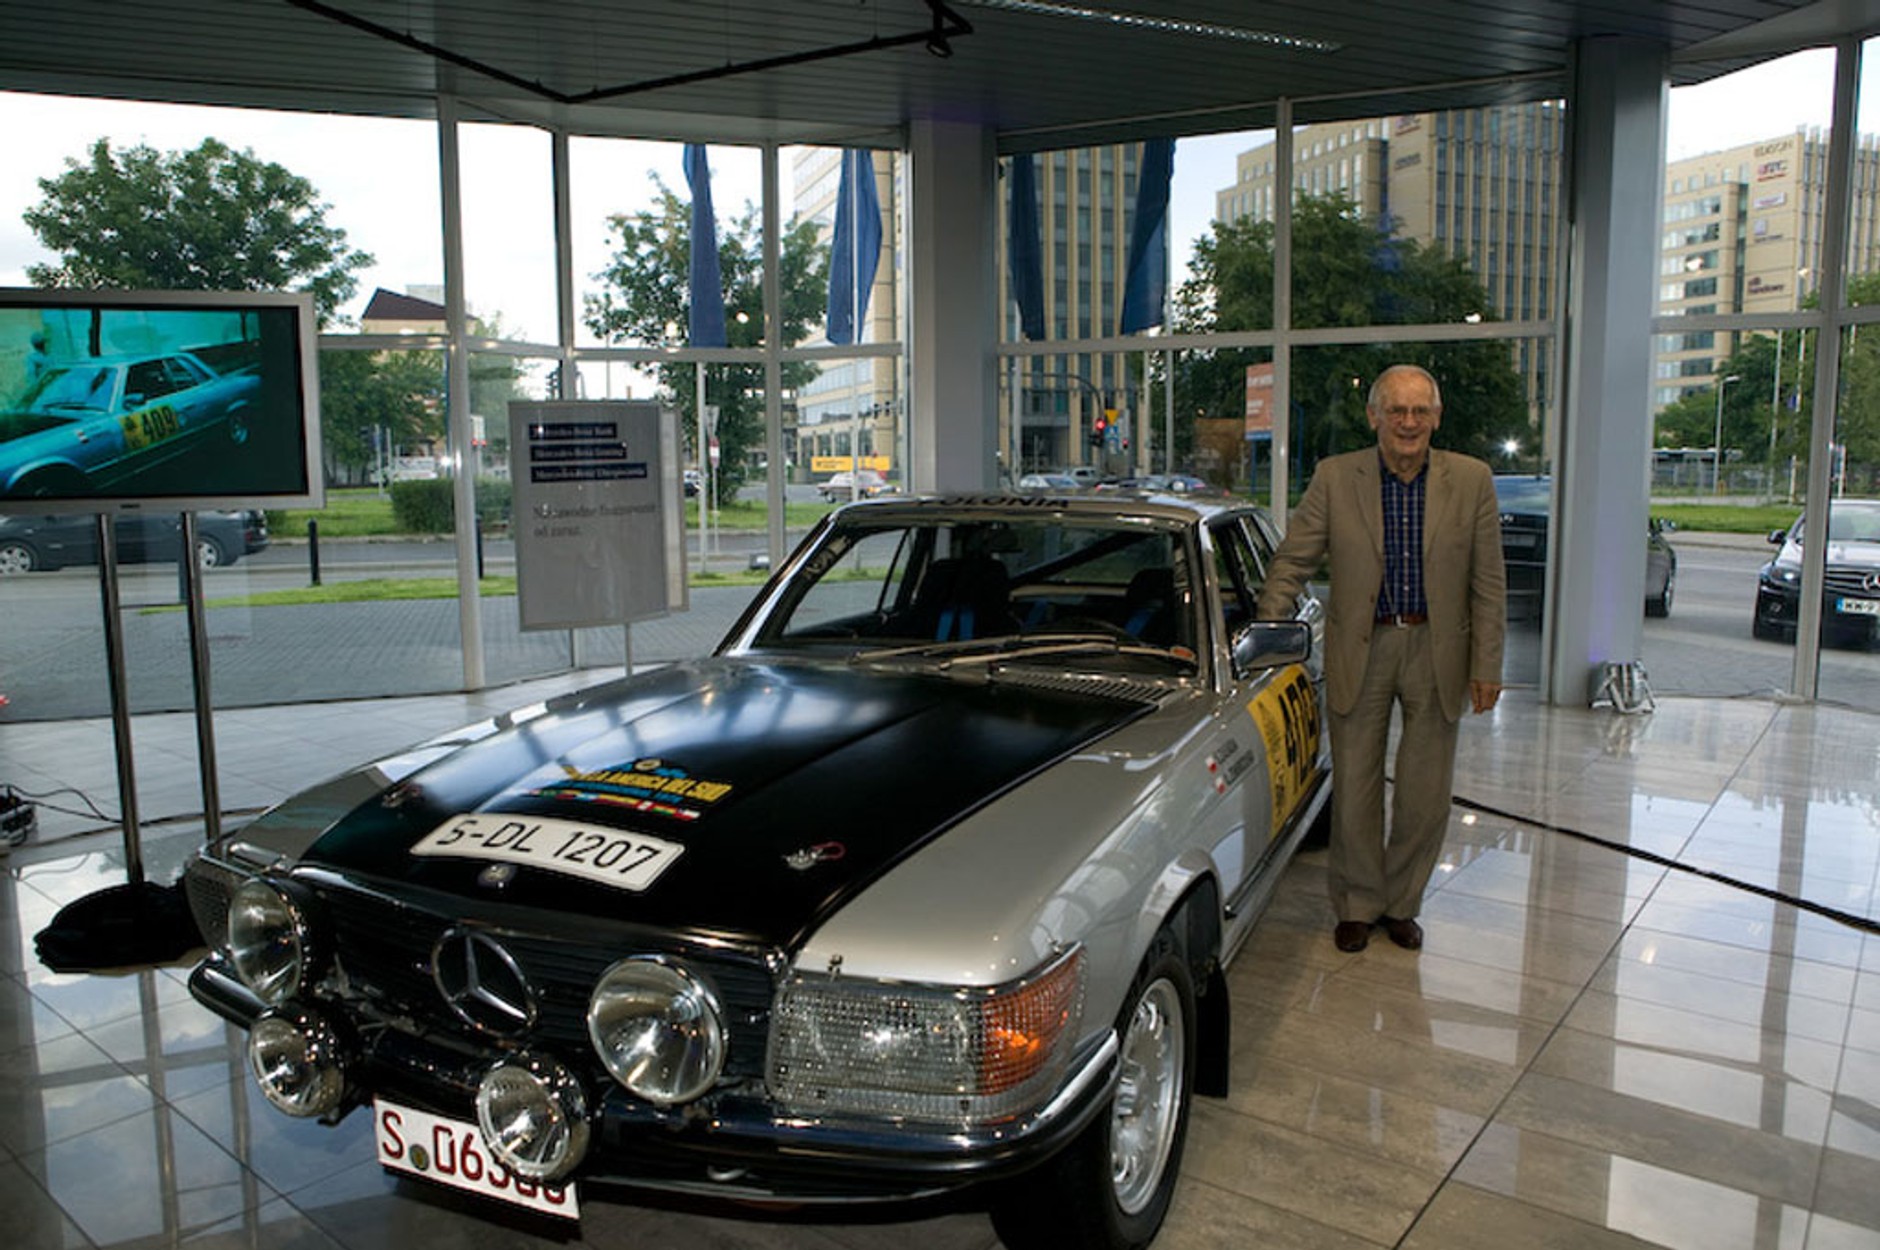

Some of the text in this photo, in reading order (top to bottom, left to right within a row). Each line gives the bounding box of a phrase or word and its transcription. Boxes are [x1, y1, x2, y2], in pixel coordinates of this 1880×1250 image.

[436, 819, 660, 875] S-DL 1207
[382, 1109, 404, 1160] S
